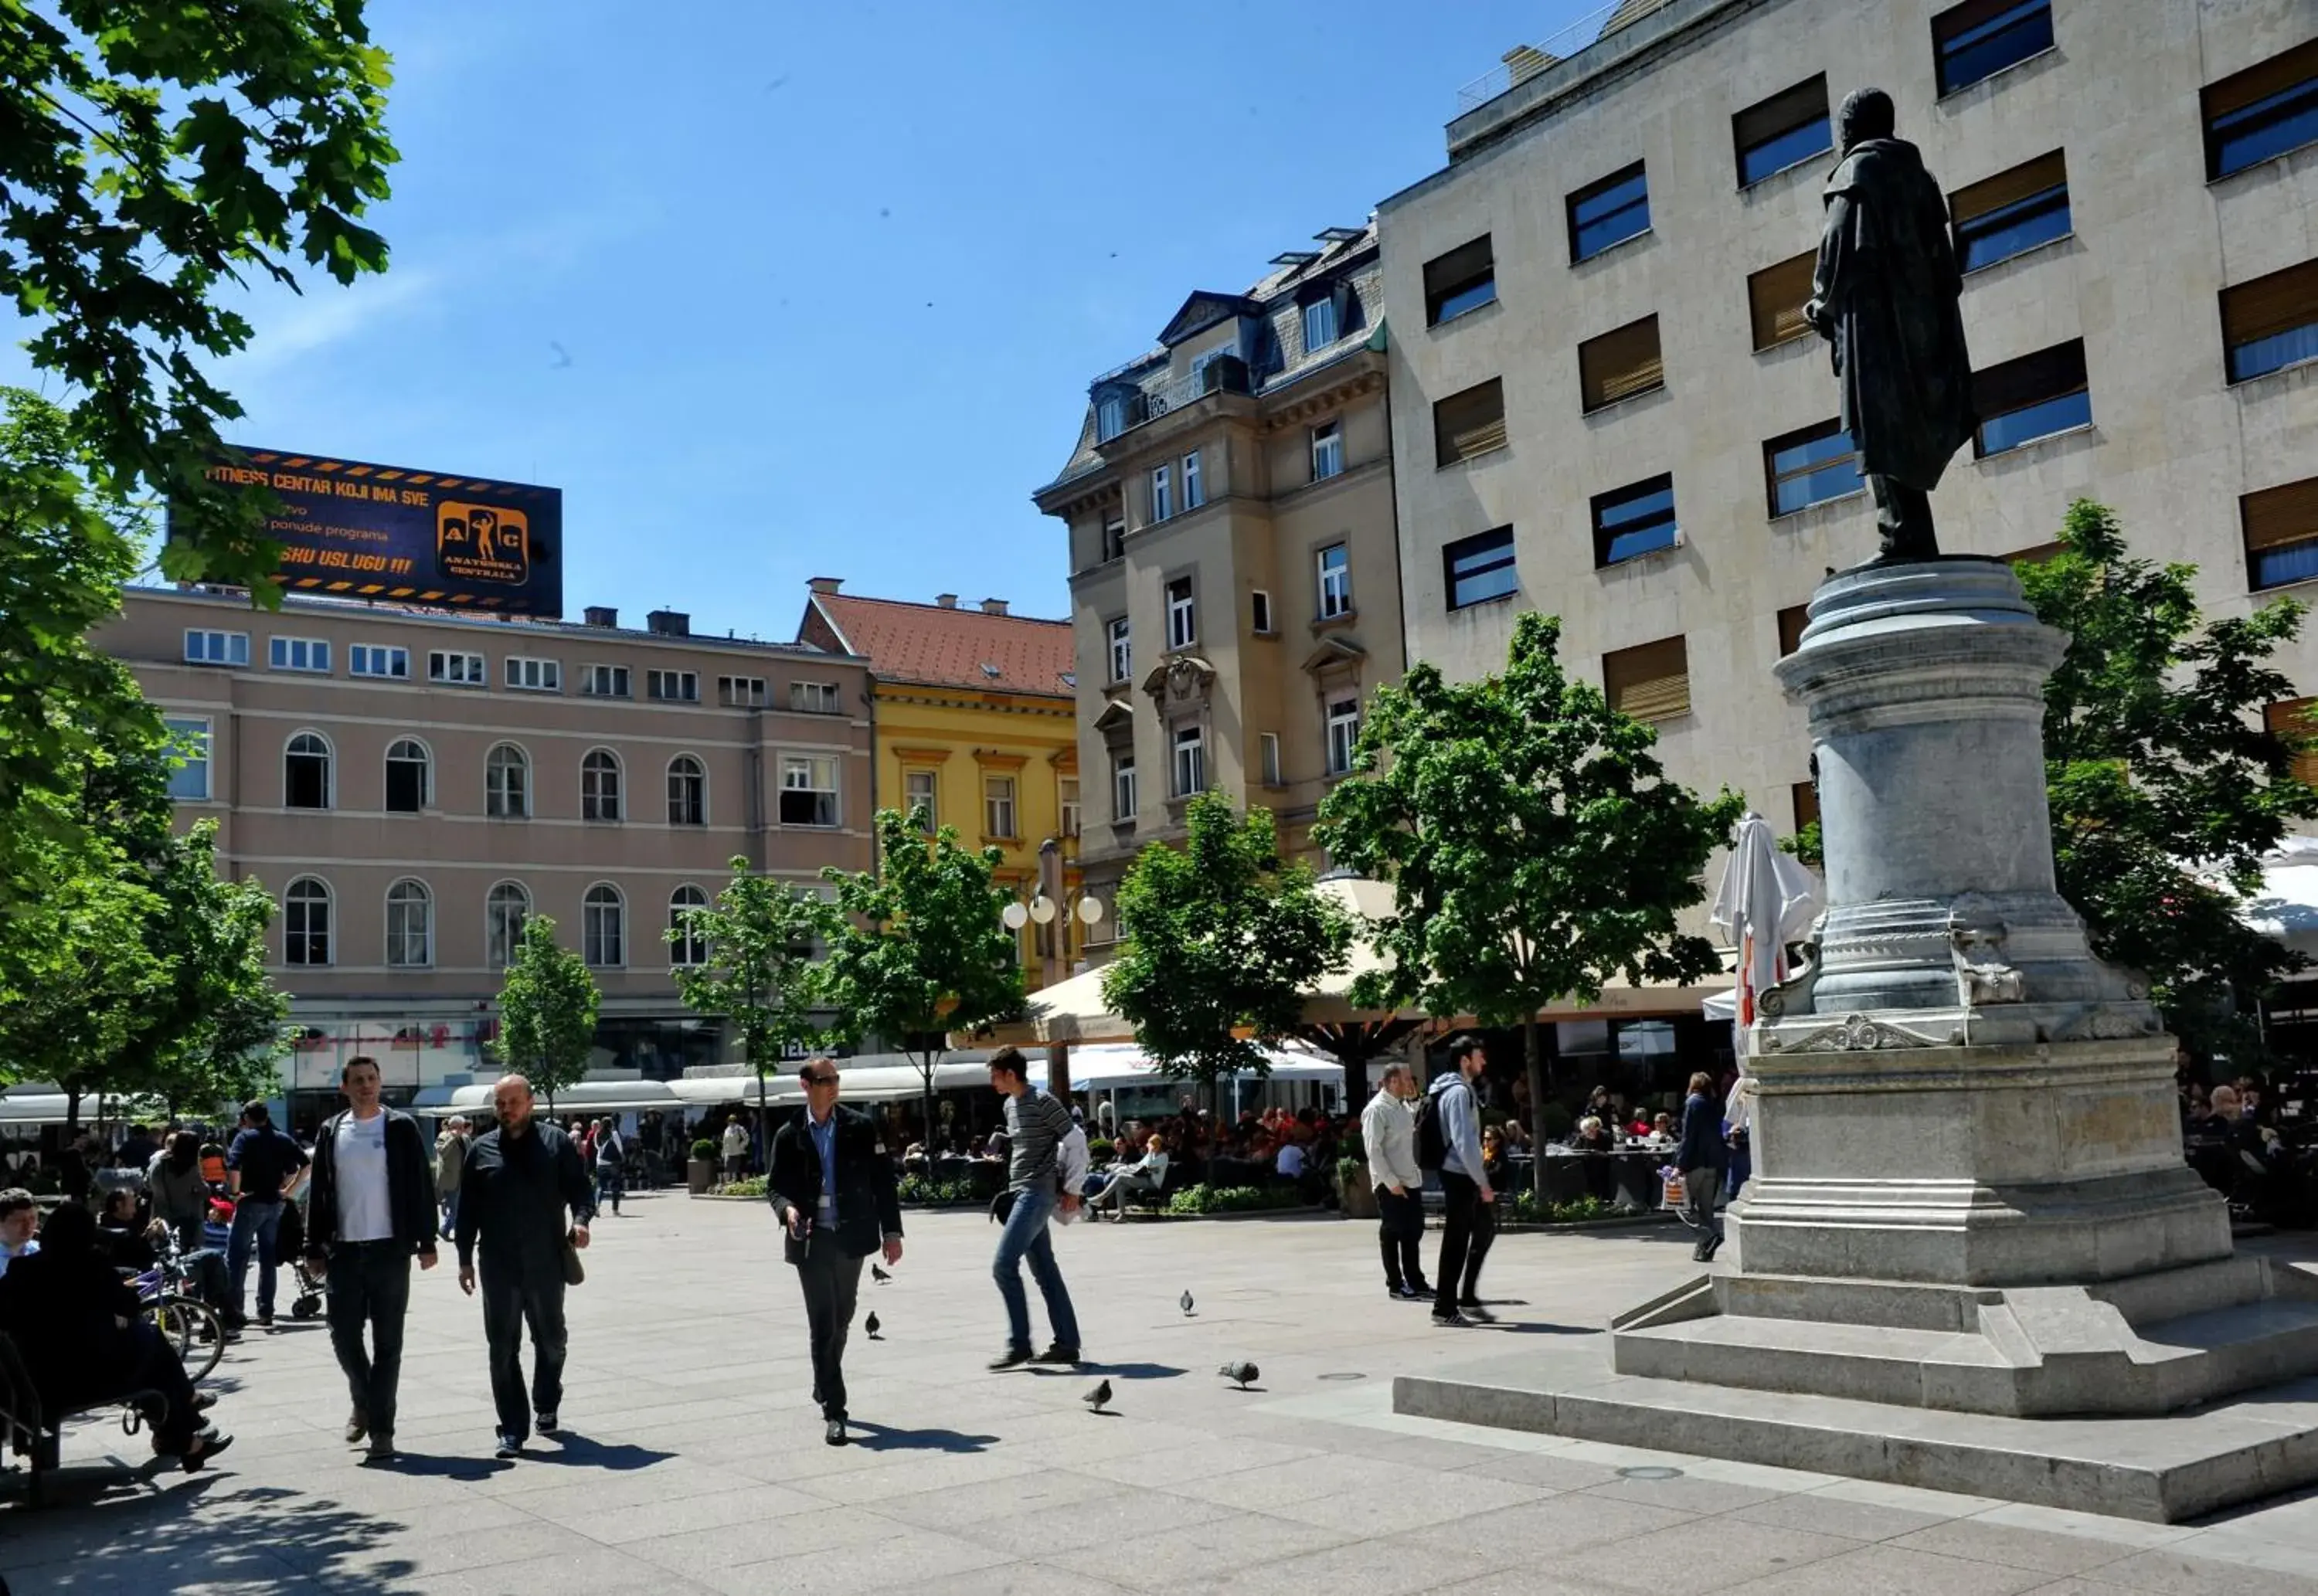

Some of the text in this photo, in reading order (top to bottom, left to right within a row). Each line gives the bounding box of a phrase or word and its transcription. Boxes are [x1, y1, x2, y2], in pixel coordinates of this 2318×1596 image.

[274, 473, 331, 494] CENTAR
[335, 481, 369, 499] KOJI
[372, 487, 396, 502] IMA
[402, 491, 429, 507] SVE
[271, 520, 322, 533] ponude
[325, 526, 389, 541] programa
[445, 527, 519, 547] A C
[318, 550, 386, 571] USLUGU
[450, 566, 516, 579] CENTRALA
